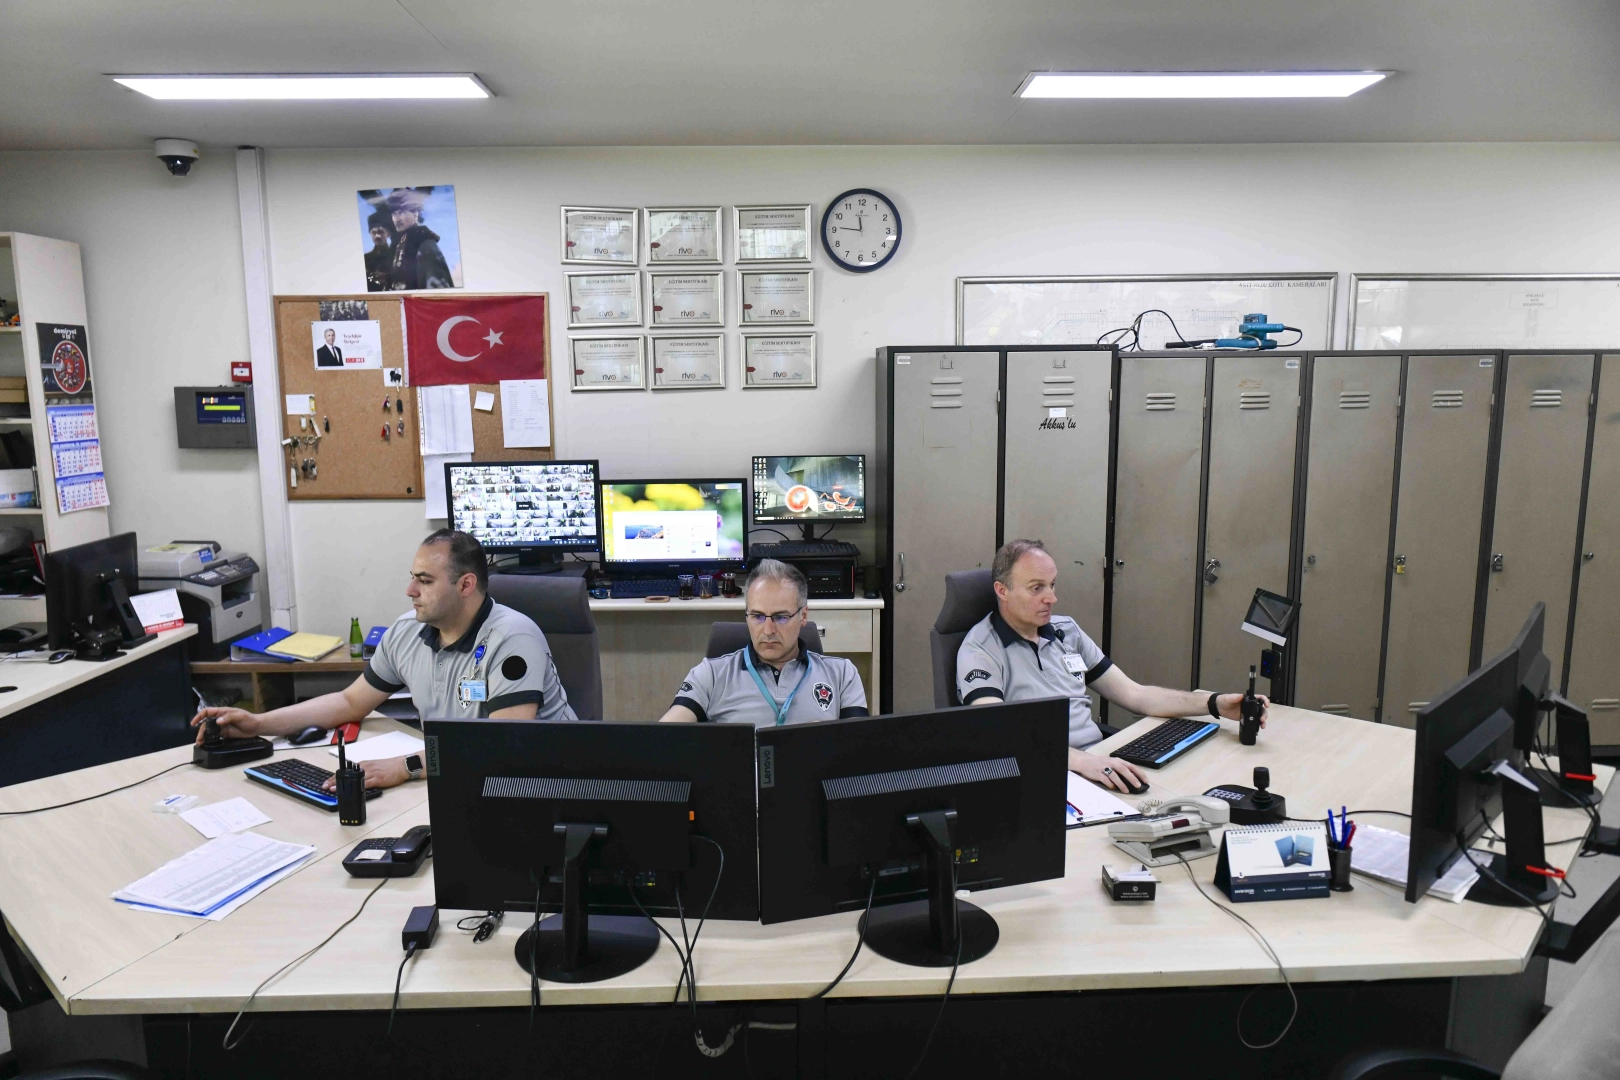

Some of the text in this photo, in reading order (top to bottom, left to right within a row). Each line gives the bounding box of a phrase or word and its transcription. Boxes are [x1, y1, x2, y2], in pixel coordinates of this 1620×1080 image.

[1039, 417, 1076, 430] Akkuş'lu
[429, 739, 437, 772] Lenovo
[763, 750, 771, 784] Lenovo
